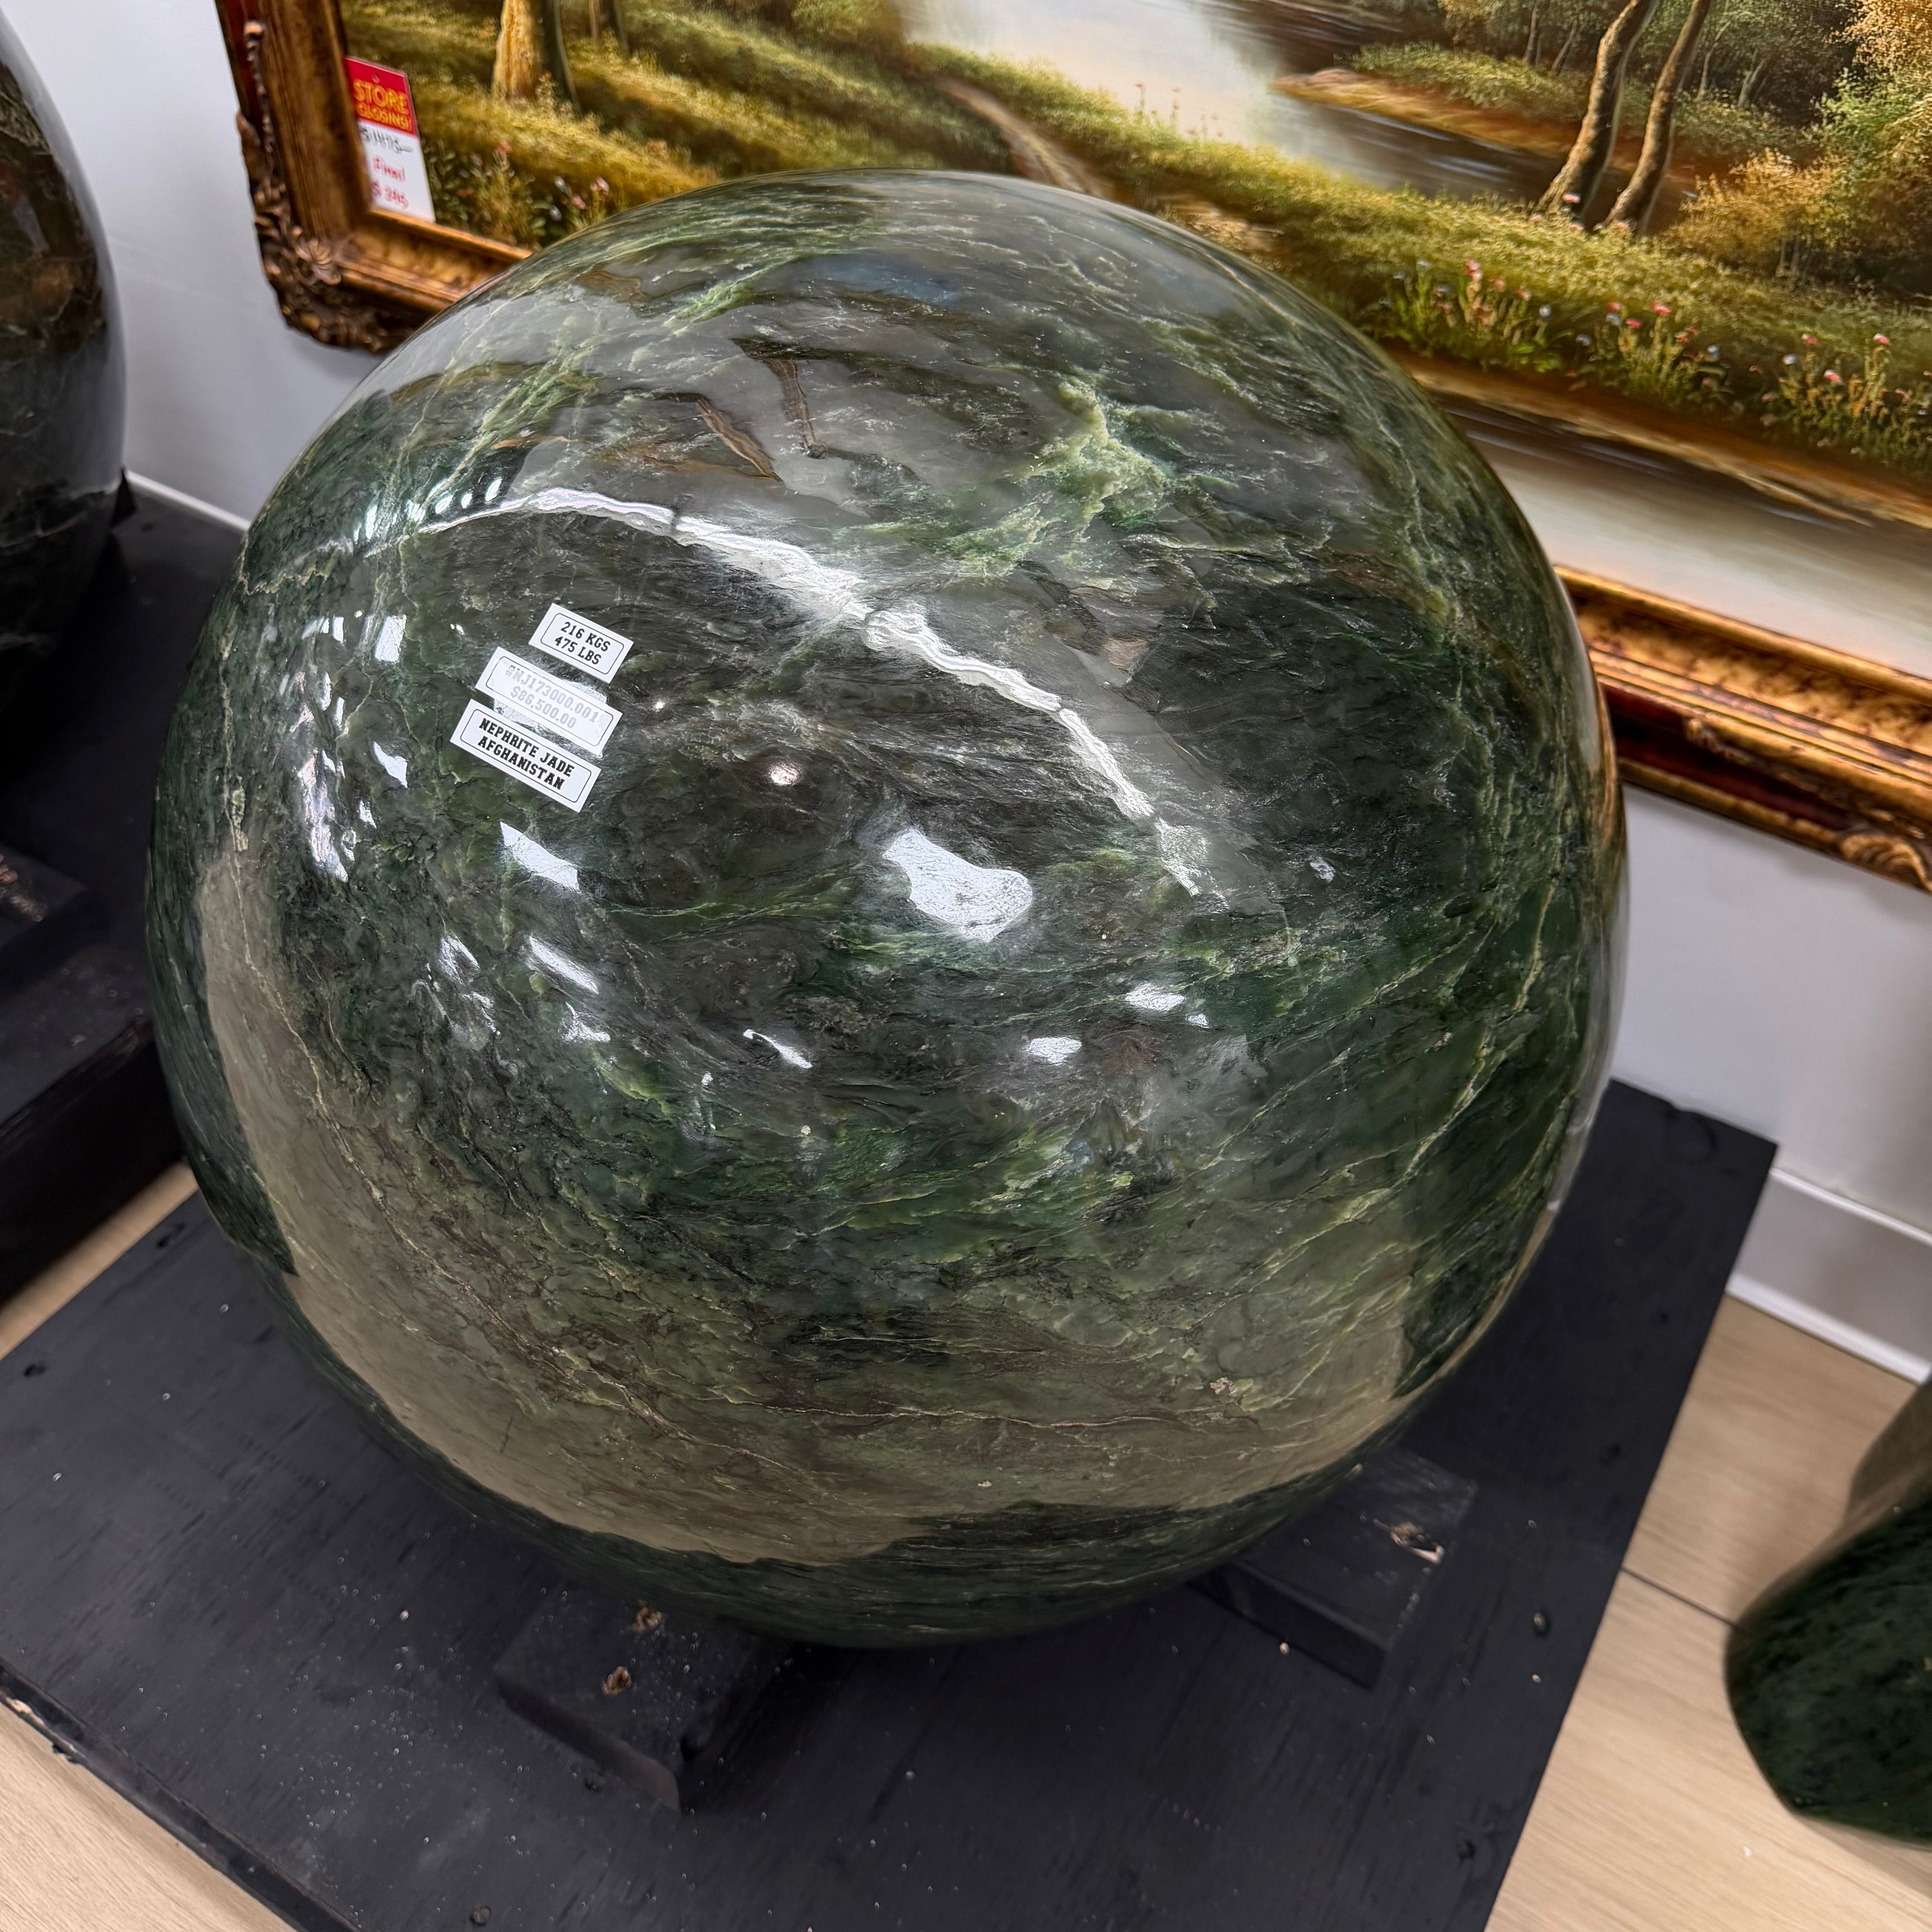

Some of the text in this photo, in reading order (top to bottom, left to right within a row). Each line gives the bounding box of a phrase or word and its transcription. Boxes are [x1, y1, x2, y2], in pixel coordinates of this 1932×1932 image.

[354, 79, 409, 114] STORE
[555, 636, 602, 665] 475 LBS
[561, 622, 611, 652] 216 KGS
[505, 665, 599, 722] #NJ173000.001
[510, 687, 577, 729] $86,500.00
[477, 736, 565, 791] AFGHANISTAN
[478, 718, 575, 777] NEPHRITE JADE
